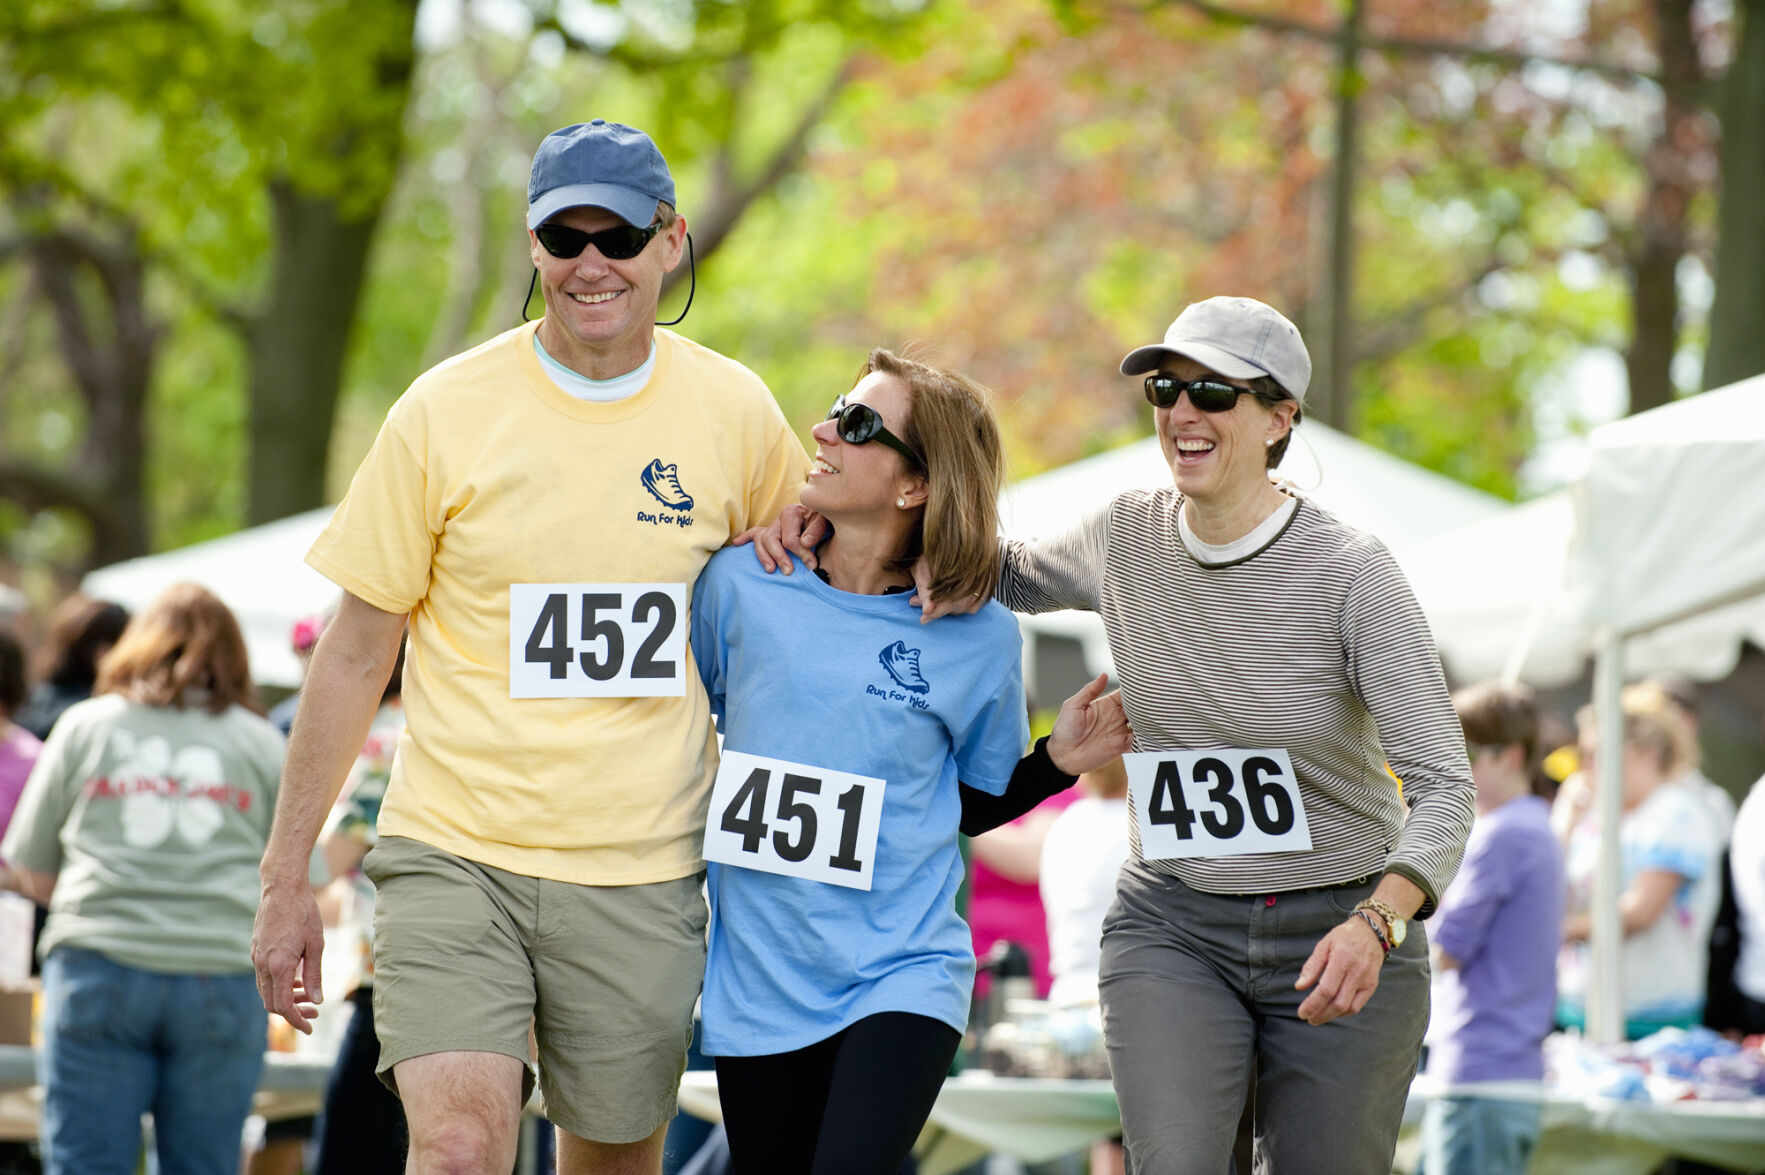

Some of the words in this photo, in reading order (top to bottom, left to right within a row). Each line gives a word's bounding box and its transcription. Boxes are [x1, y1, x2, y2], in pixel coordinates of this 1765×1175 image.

[637, 511, 657, 525] Run
[659, 513, 674, 524] For
[676, 514, 694, 528] Kids
[525, 592, 677, 680] 452
[866, 684, 887, 700] Run
[889, 690, 906, 701] For
[909, 695, 930, 710] Kids
[721, 768, 865, 872] 451
[1149, 757, 1295, 839] 436
